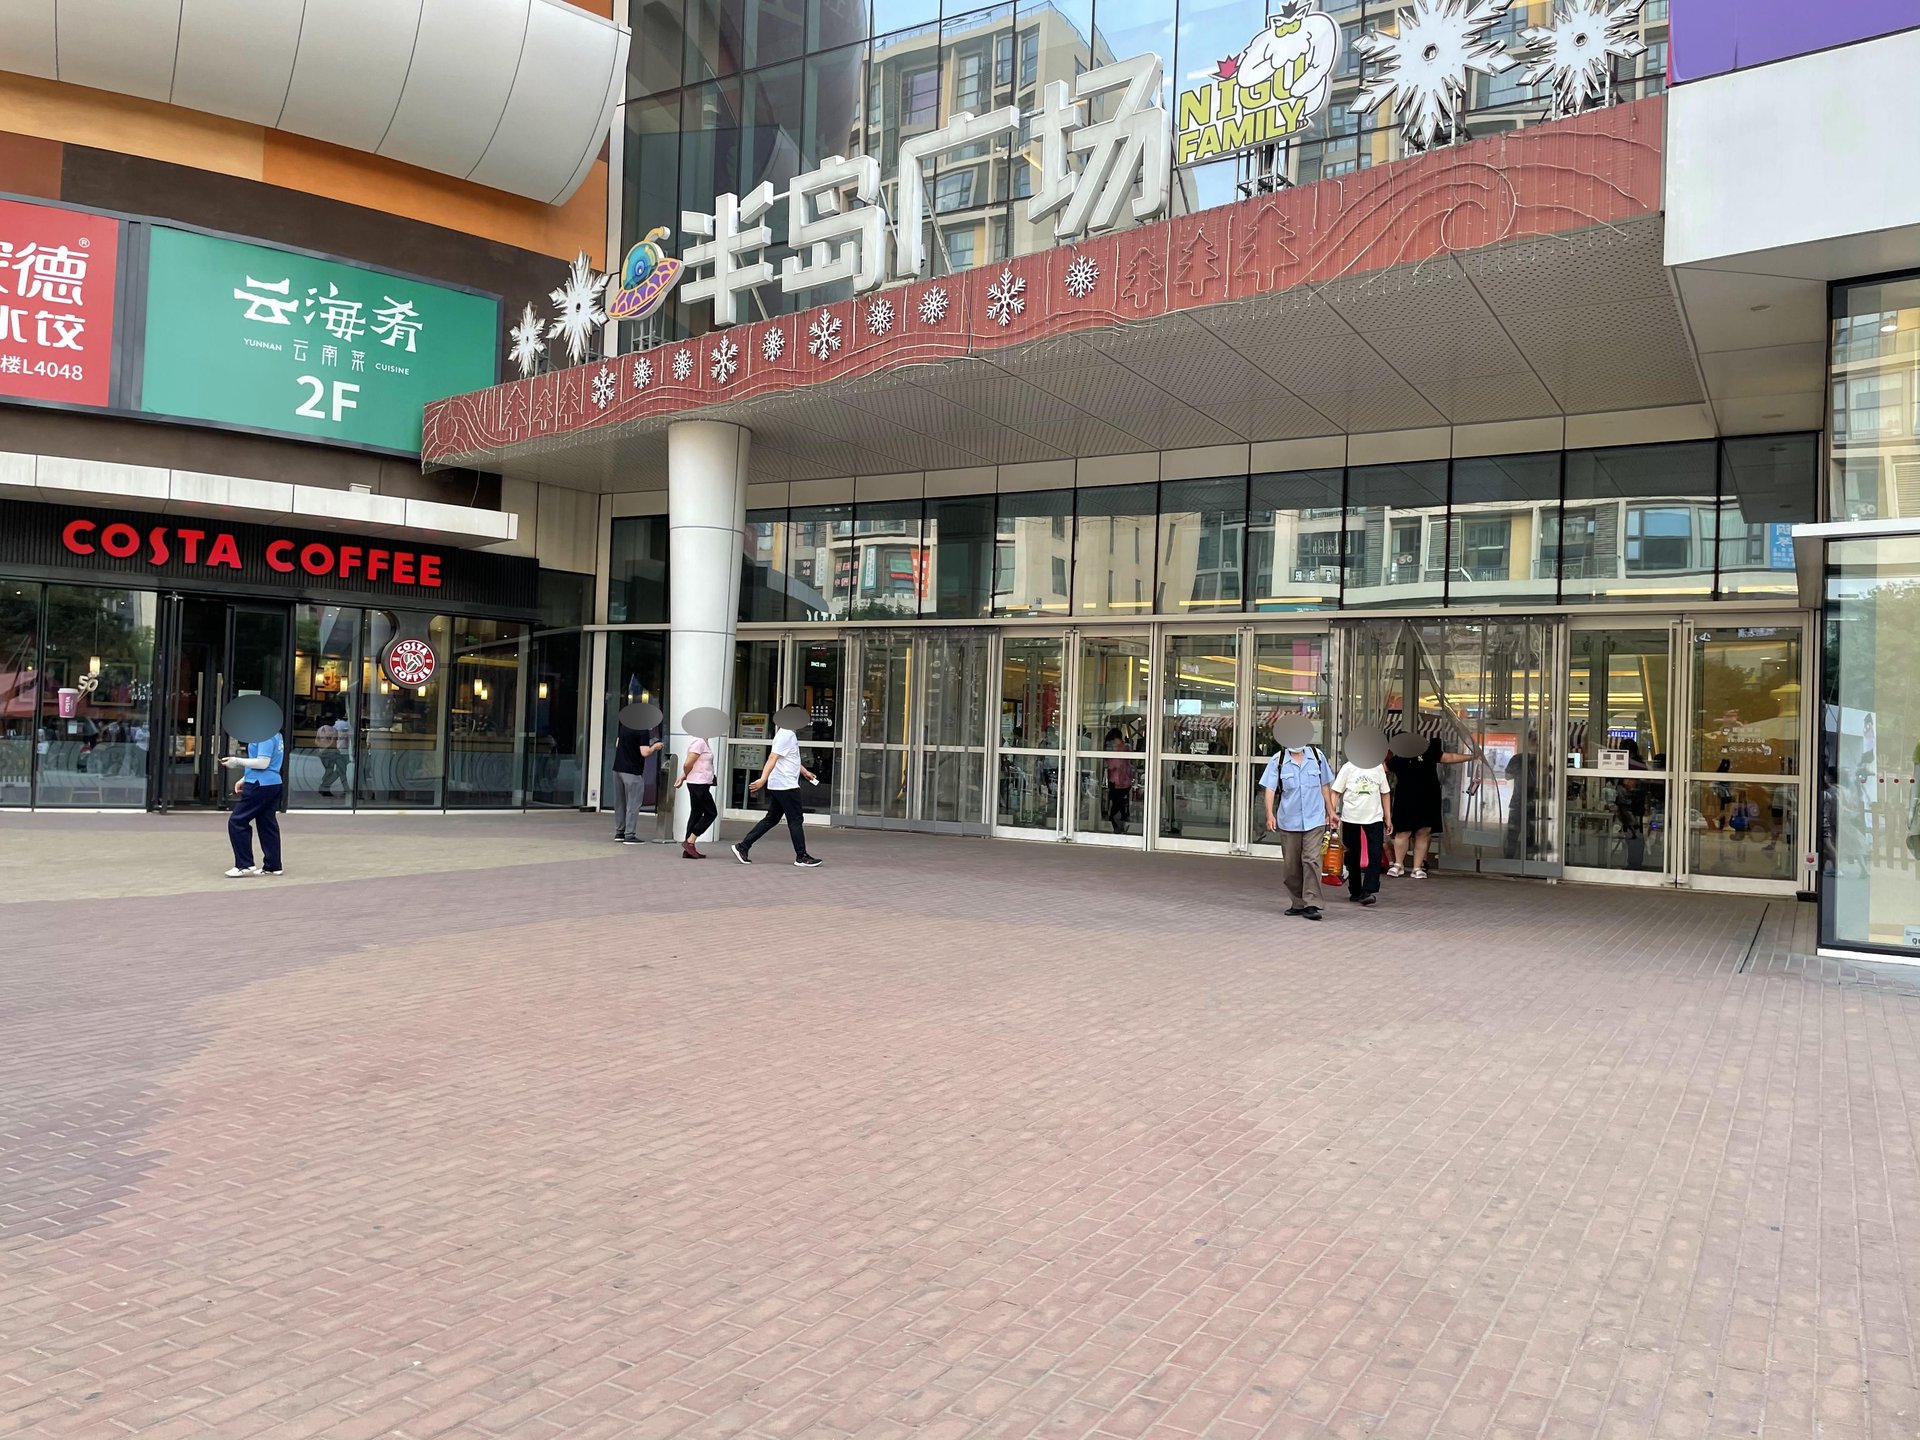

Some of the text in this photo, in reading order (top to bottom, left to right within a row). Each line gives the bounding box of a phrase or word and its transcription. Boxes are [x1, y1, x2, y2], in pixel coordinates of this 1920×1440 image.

[1178, 97, 1307, 164] FAMILY
[681, 52, 1169, 326] 半岛广场
[233, 275, 423, 353] 云海肴
[243, 337, 410, 376] YUNNAN 云南菜 CUISINE
[295, 375, 360, 422] 2F
[62, 519, 442, 587] COSTA COFFEE
[393, 666, 431, 682] COFFEE
[396, 642, 428, 656] COSTA
